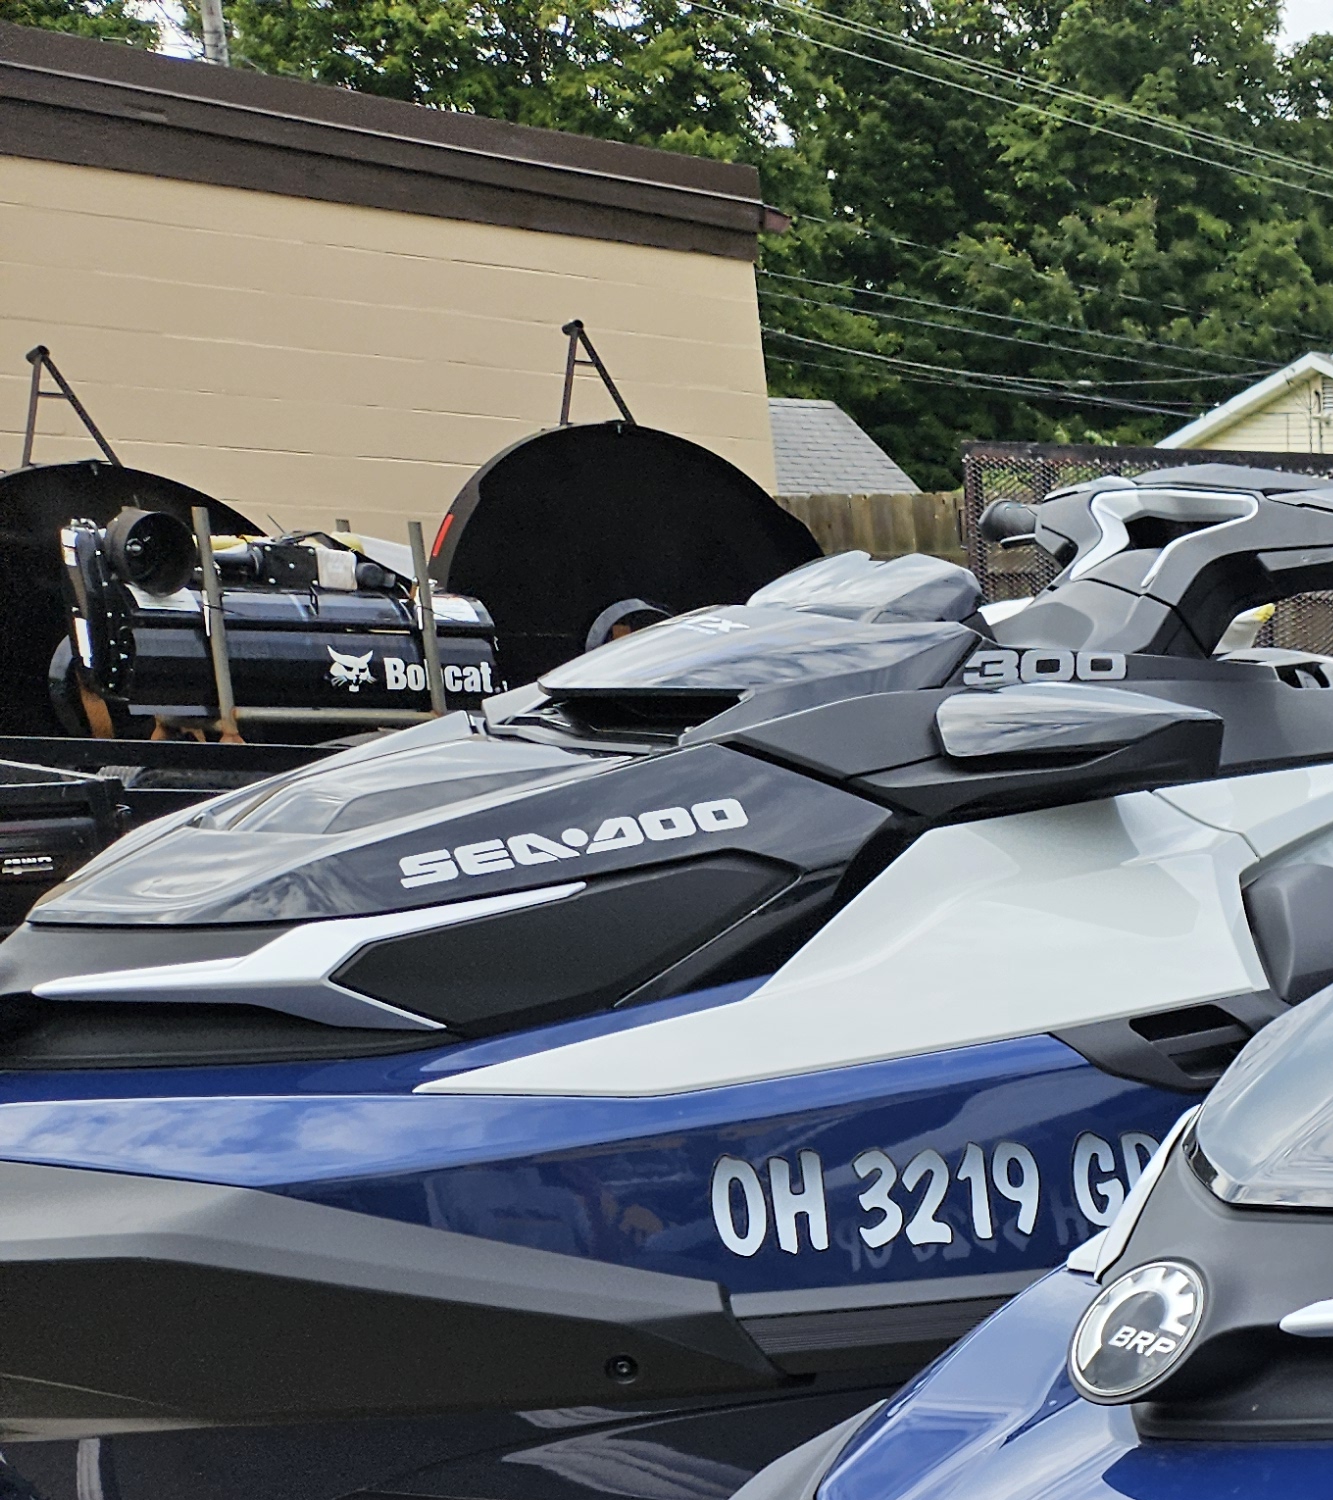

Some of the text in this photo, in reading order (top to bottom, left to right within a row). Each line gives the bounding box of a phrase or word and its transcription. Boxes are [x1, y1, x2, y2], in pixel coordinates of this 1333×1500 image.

[963, 650, 1127, 686] 300
[711, 1149, 829, 1257] OH
[852, 1141, 1039, 1250] 3219
[1108, 1325, 1177, 1358] BRP
